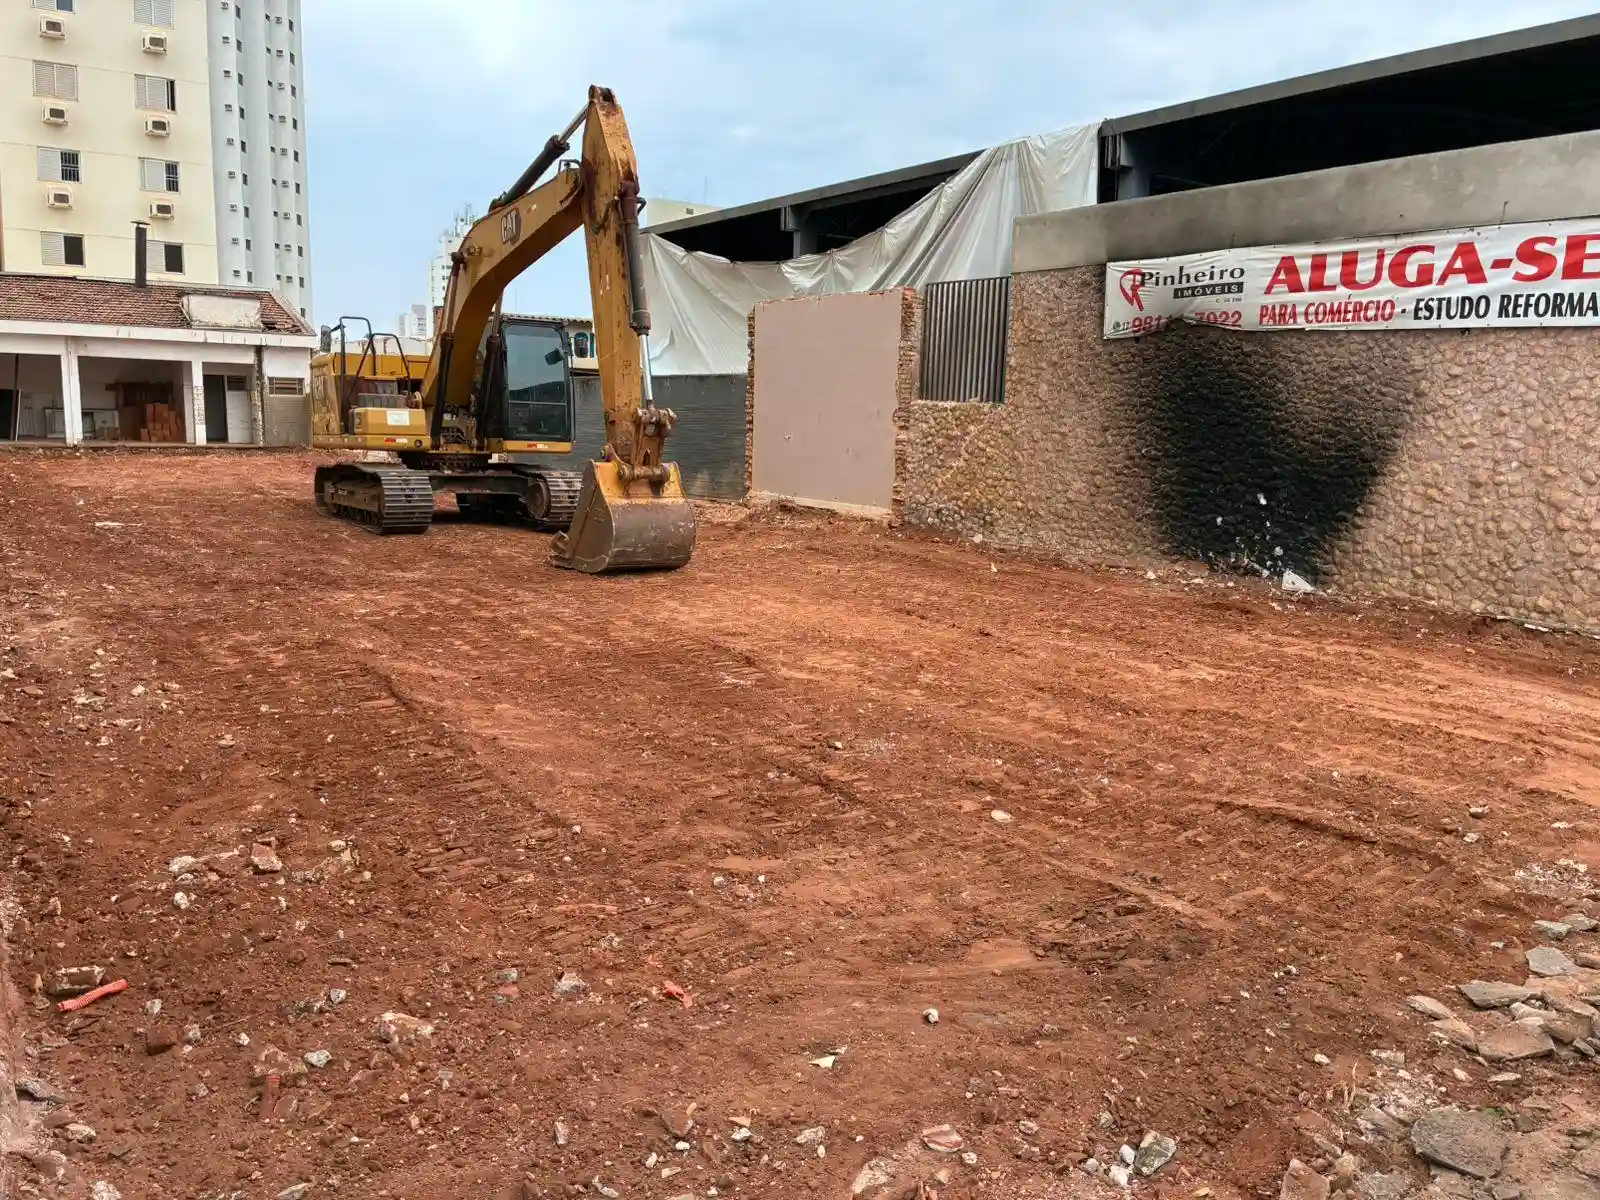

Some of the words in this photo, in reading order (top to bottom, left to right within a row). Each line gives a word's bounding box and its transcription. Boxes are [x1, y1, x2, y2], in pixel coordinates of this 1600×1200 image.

[501, 209, 517, 243] CAT
[1140, 265, 1245, 287] Pinheiro
[1264, 234, 1600, 295] ALUGA-SE
[1259, 303, 1298, 325] PARA
[1304, 294, 1396, 324] COMÉRCIO
[1413, 294, 1491, 320] ESTUDO
[1498, 292, 1599, 318] REFORMA
